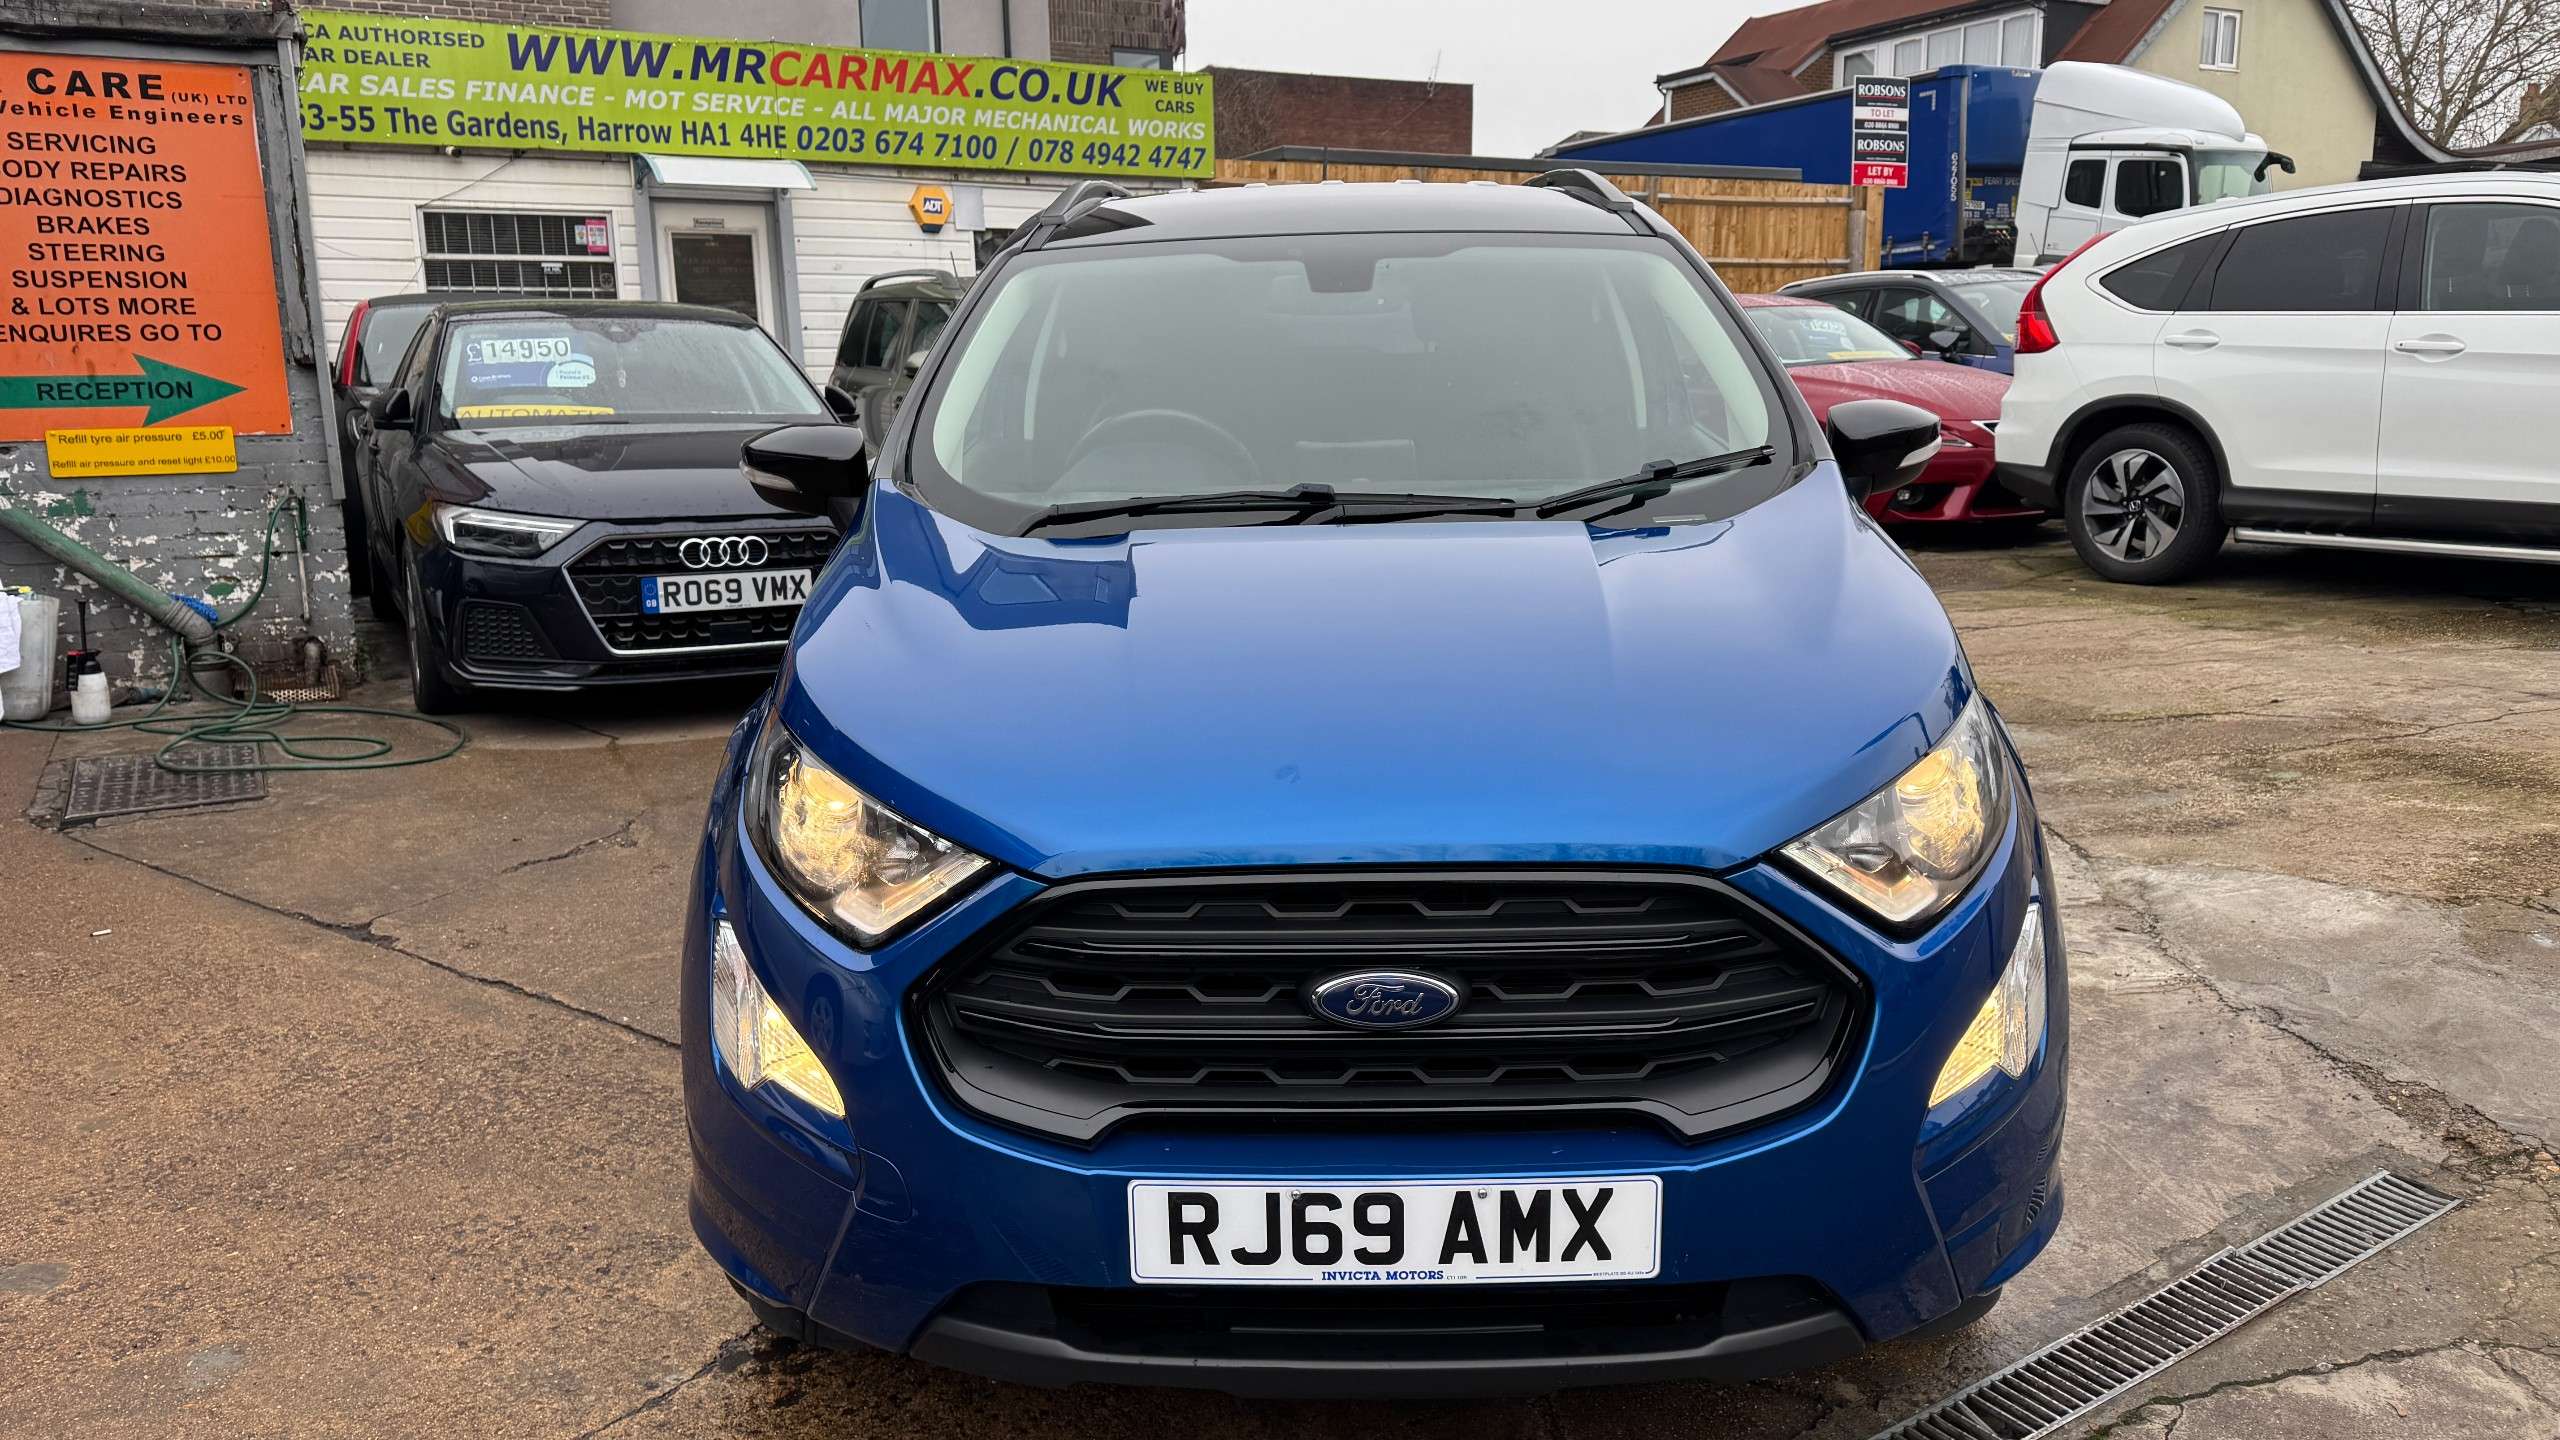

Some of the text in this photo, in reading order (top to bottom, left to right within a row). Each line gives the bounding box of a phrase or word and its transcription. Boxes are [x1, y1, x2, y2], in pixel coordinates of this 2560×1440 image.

[302, 23, 486, 49] CA AUTHORISED
[303, 48, 431, 69] AR DEALER
[506, 32, 1128, 108] WWW.MRCARMAX.CO.UK
[26, 67, 248, 106] CARE (UK) LTD
[1145, 79, 1204, 96] WE BUY
[1858, 84, 1906, 97] ROBSONS
[109, 105, 244, 126] Engineers
[299, 72, 349, 95] AR
[359, 75, 456, 100] SALES
[465, 79, 596, 107] FINANCE
[624, 89, 685, 110] MOT
[692, 92, 807, 117] SERVICE
[831, 101, 876, 121] ALL
[884, 103, 966, 126] MAJOR
[974, 108, 1120, 135] MECHANICAL
[1128, 118, 1206, 141] WORKS
[1155, 100, 1195, 114] CARS
[1871, 109, 1895, 118] TO LET
[6, 131, 157, 155] SERVICING
[384, 106, 438, 135] The
[447, 109, 568, 145] Gardens,
[577, 115, 672, 144] Harrow
[681, 120, 731, 147] HA1
[740, 123, 787, 149] 4HE
[797, 125, 866, 153] 0203
[875, 129, 923, 156] 674
[934, 132, 997, 160] 7100
[1029, 137, 1075, 164] 078
[1082, 142, 1140, 167] 4942
[1148, 146, 1207, 170] 4747
[1857, 139, 1905, 152] ROBSONS
[2, 159, 187, 183] ODY REPAIRS
[1868, 166, 1894, 177] LET BY
[922, 199, 943, 213] ADT
[36, 215, 151, 236] BRAKES
[28, 242, 165, 263] STEERING
[11, 269, 188, 289] SUSPENSION
[11, 296, 197, 315] & LOTS MORE
[140, 323, 180, 342] GO
[187, 323, 222, 341] TO
[36, 380, 194, 402] RECEPTION
[58, 433, 87, 444] Refill
[90, 433, 113, 446] tyre
[115, 432, 131, 443] air
[133, 432, 183, 445] pressure
[52, 460, 77, 469] Refill
[80, 460, 91, 468] air
[94, 459, 135, 469] pressure
[138, 457, 155, 466] and
[158, 457, 181, 466] reset
[662, 574, 807, 608] RO69 VMX
[1346, 983, 1424, 1016] Ford
[1167, 1187, 1615, 1266] RJ69 AMX
[1321, 1270, 1381, 1281] INVICTA
[1385, 1270, 1444, 1281] MOTORS
